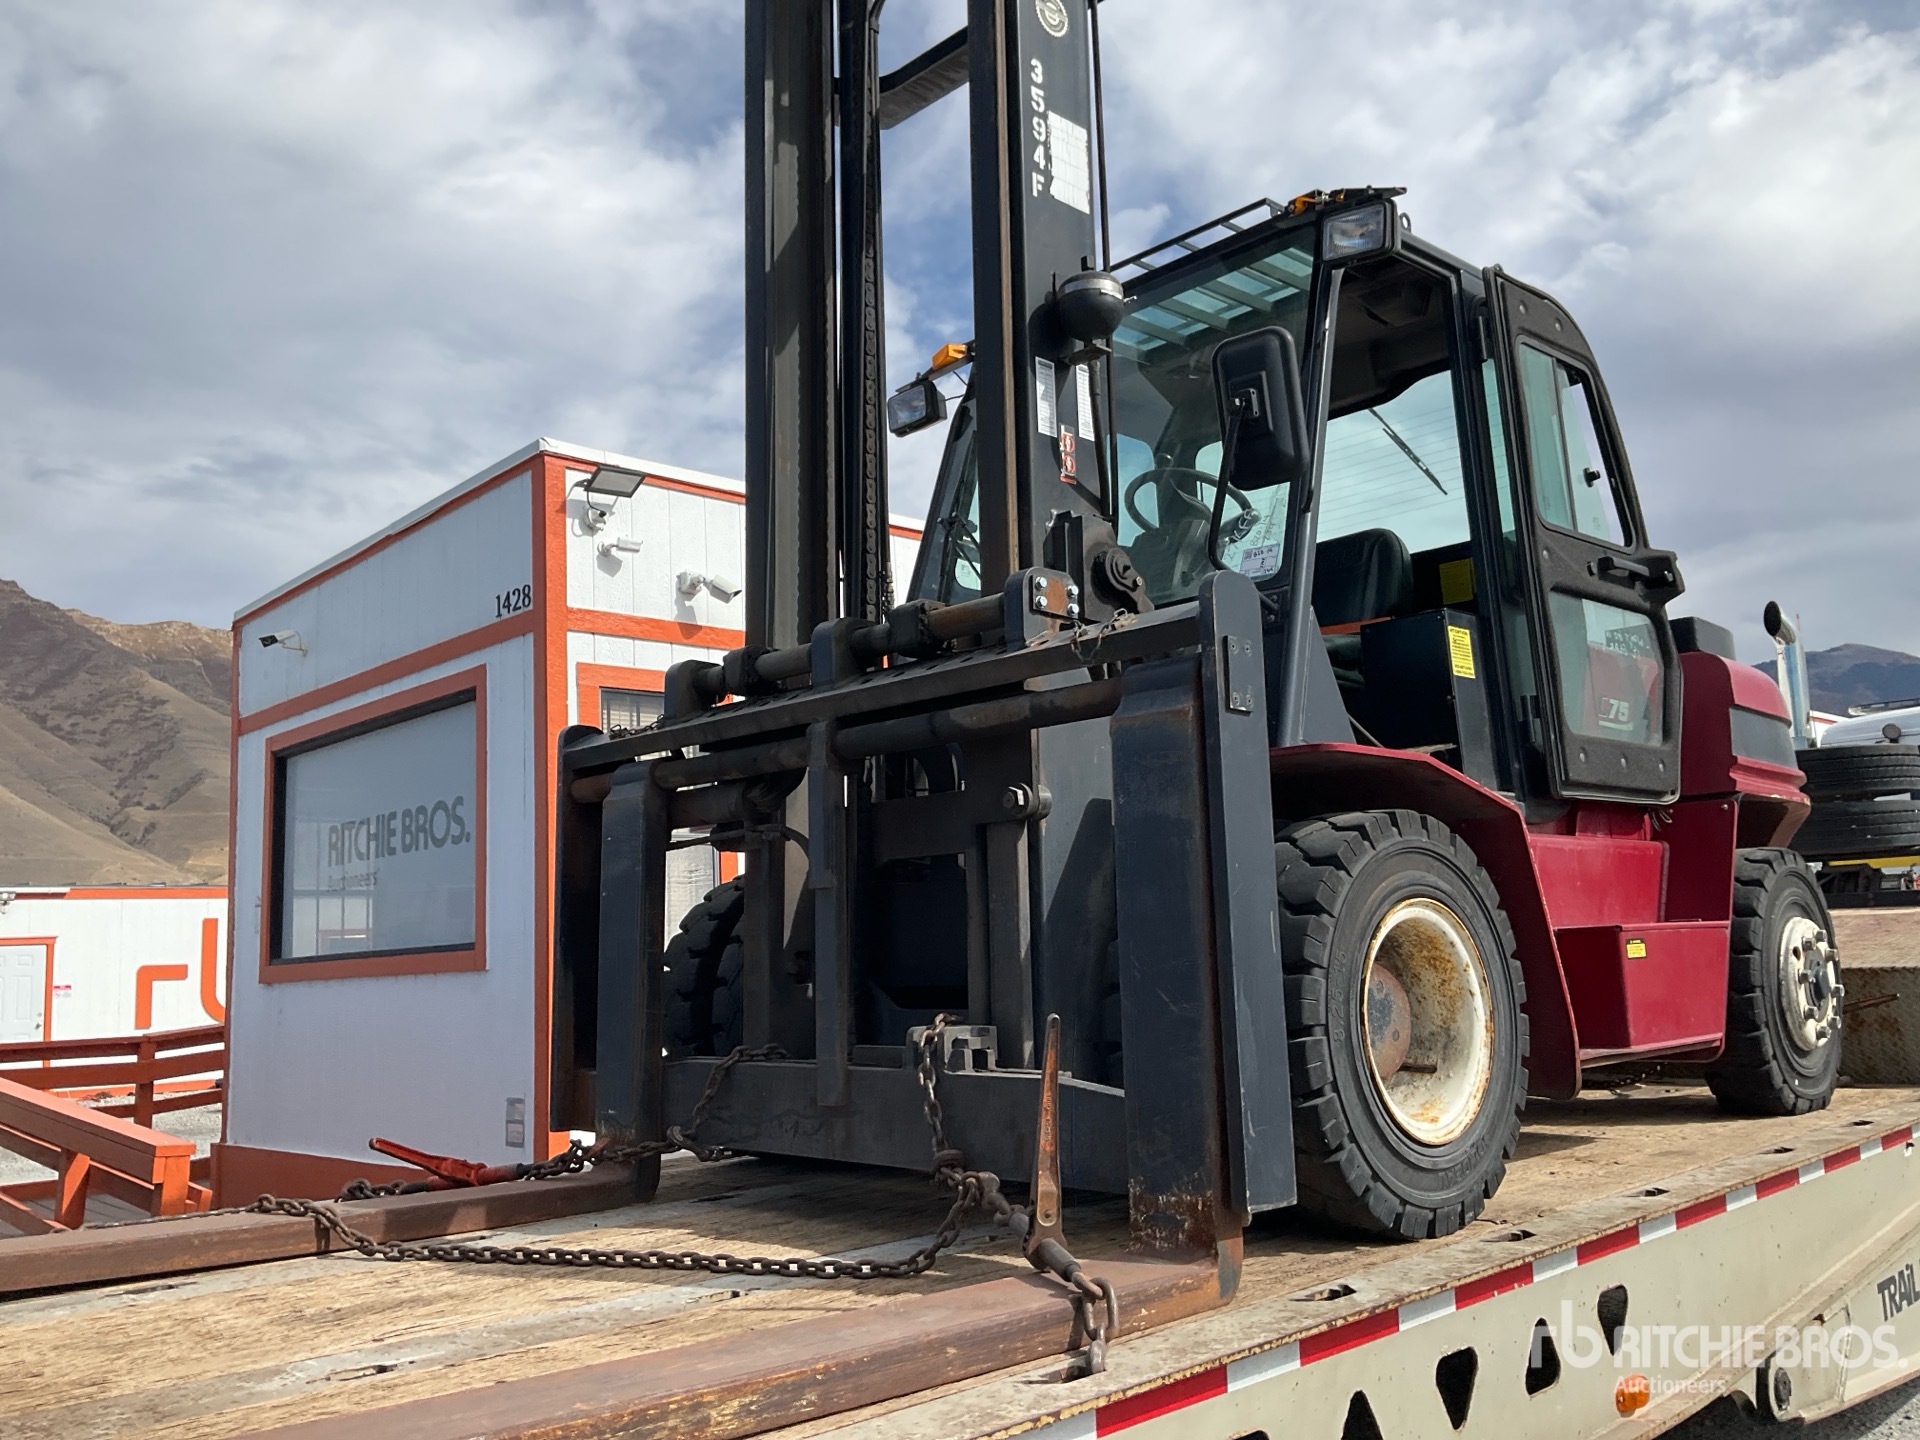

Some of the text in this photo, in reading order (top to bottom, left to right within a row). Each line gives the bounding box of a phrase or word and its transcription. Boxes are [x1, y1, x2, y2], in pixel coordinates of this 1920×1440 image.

[1030, 58, 1047, 197] 3594F
[495, 584, 532, 618] 1428
[328, 795, 471, 867] RITCHIE BROS.
